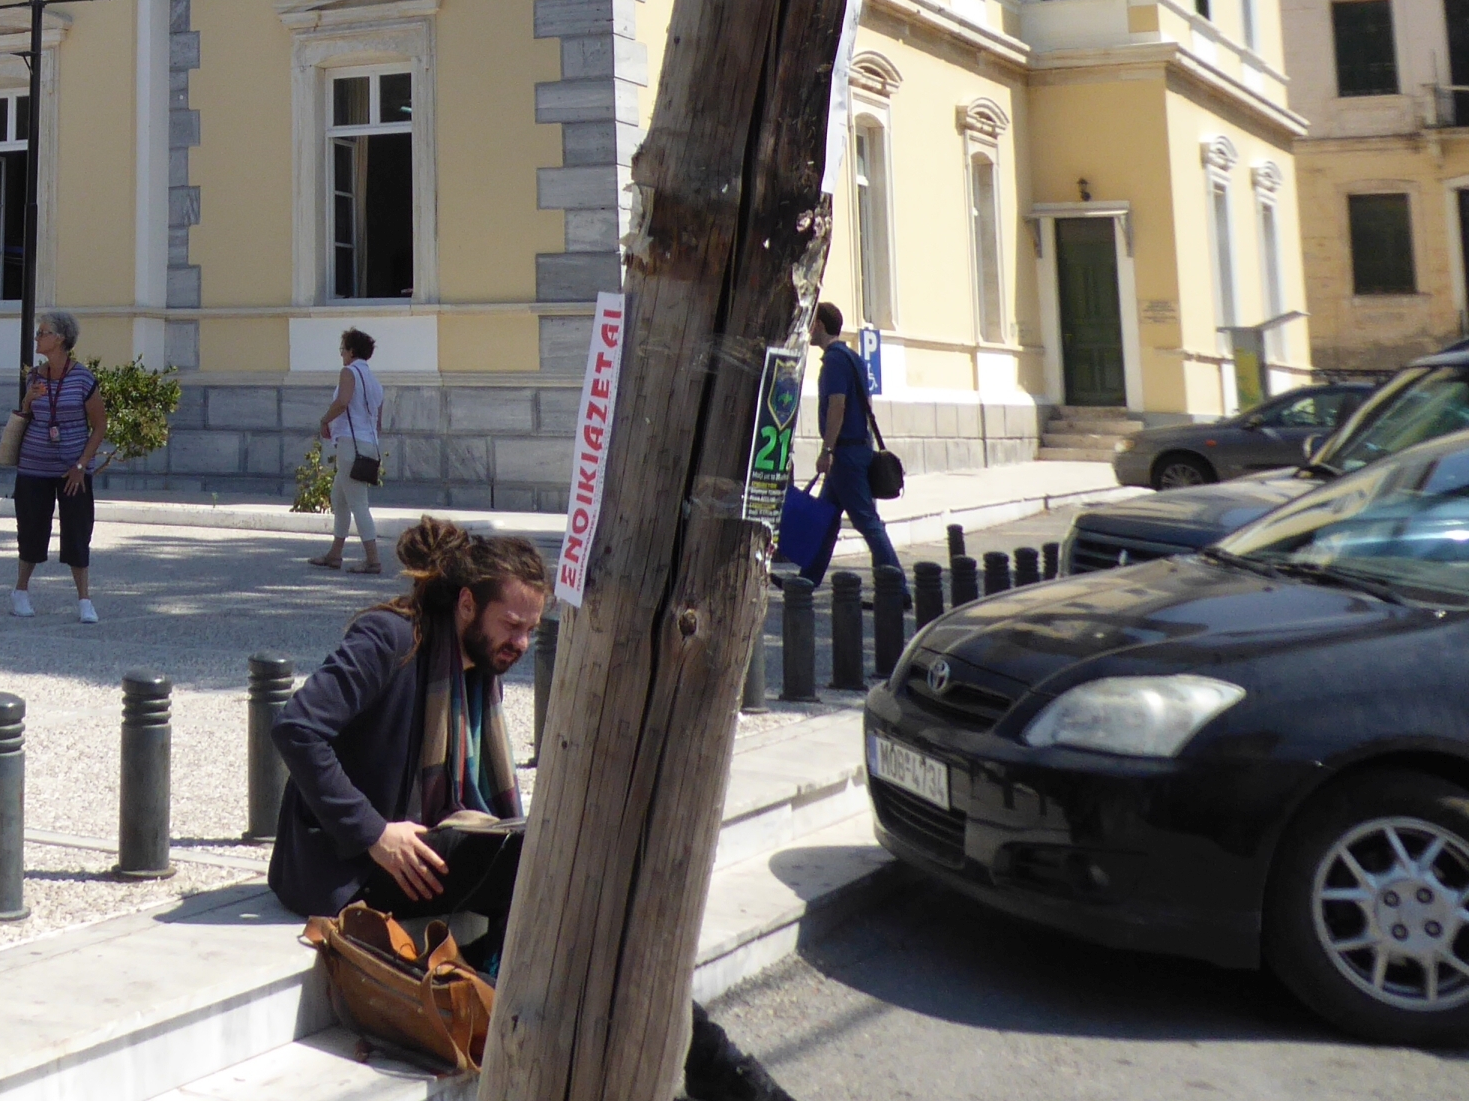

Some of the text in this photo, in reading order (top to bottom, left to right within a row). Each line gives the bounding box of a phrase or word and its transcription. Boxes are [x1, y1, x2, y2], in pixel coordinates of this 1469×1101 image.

[863, 330, 878, 361] P
[560, 309, 622, 588] ΕΝΟΙΚΙΑΖΕΤΑΙ
[754, 425, 792, 471] 21
